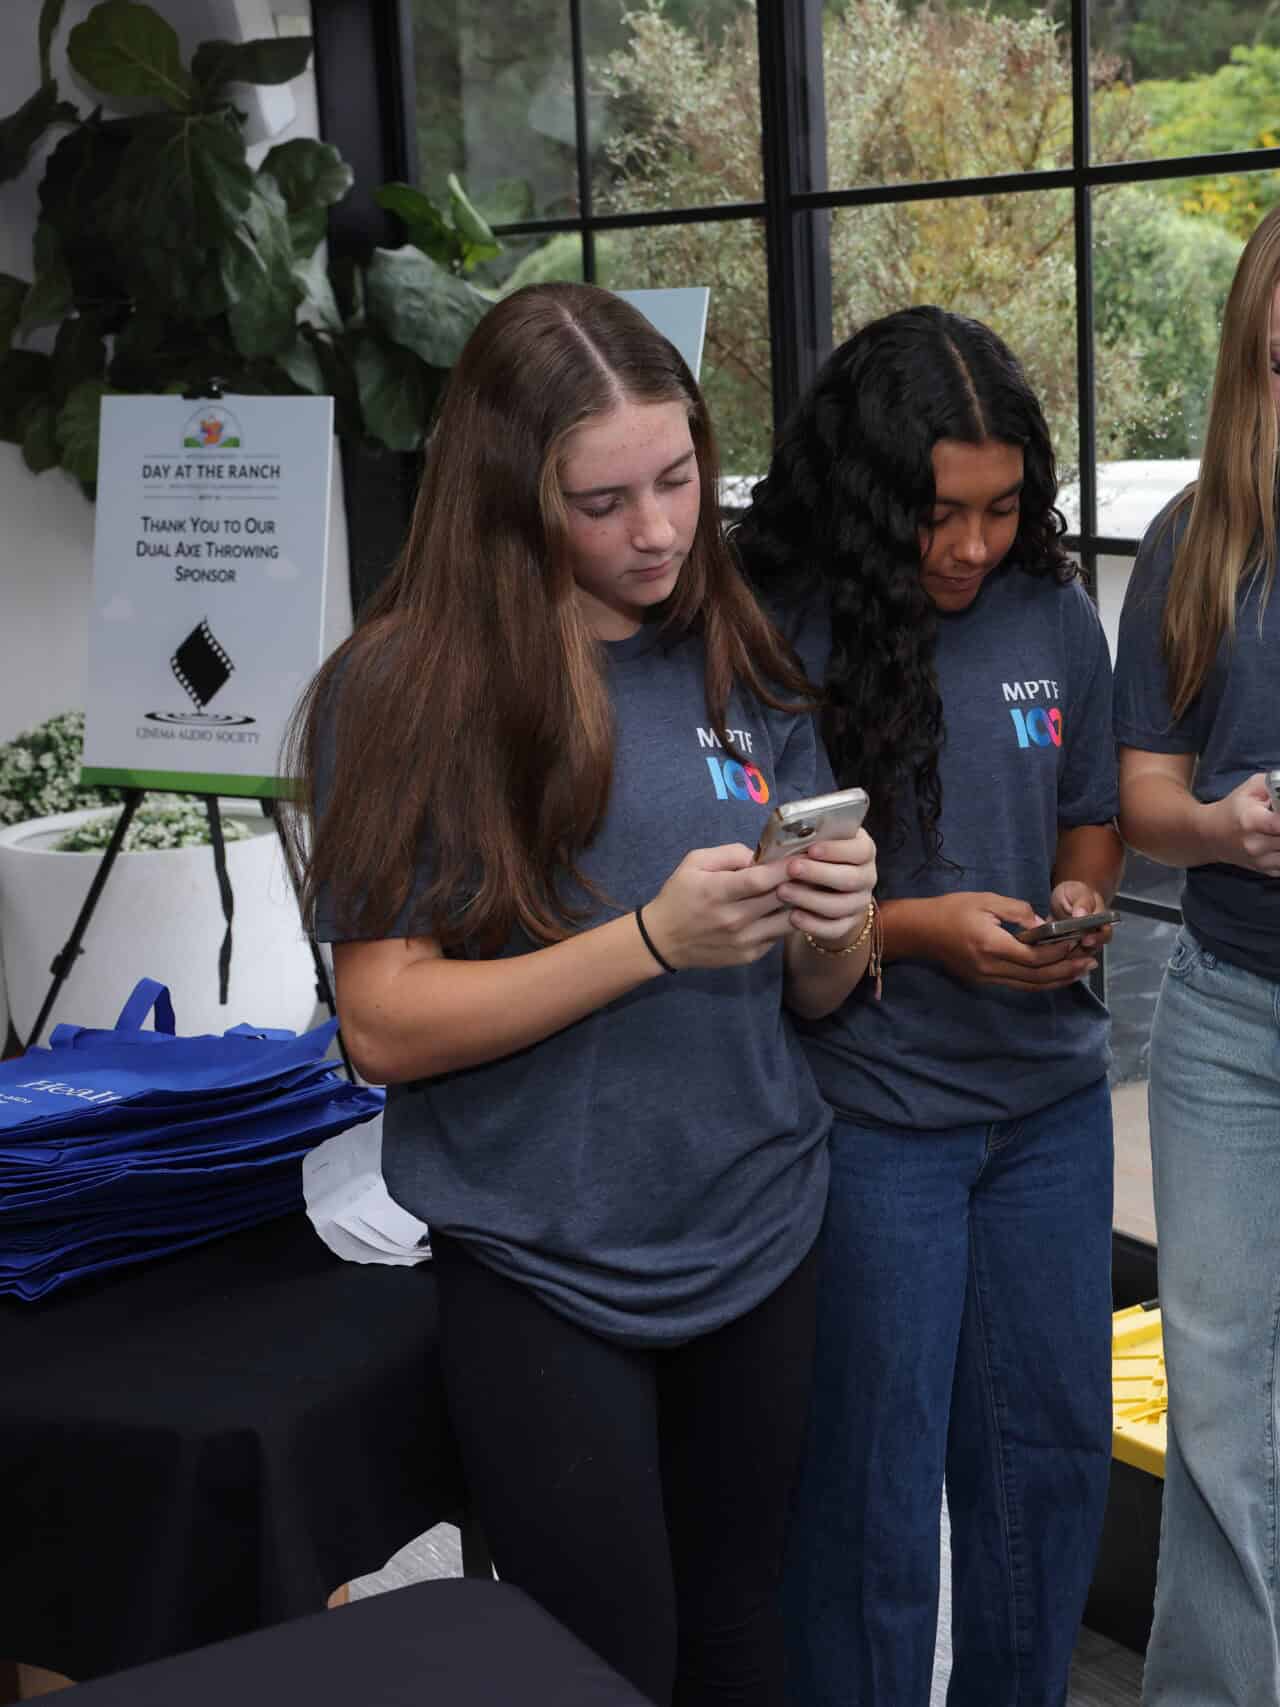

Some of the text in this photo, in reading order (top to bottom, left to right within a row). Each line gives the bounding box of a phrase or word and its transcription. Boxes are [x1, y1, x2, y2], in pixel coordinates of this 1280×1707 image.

[142, 464, 281, 479] DAY AT THE RANCH
[141, 516, 275, 534] THANK YOU TO OUR
[136, 540, 279, 559] DUAL AXE THROWING
[175, 565, 237, 583] SPONSOR
[179, 728, 213, 742] AUDIO
[216, 730, 260, 744] SOCIETY
[705, 756, 769, 804] 100
